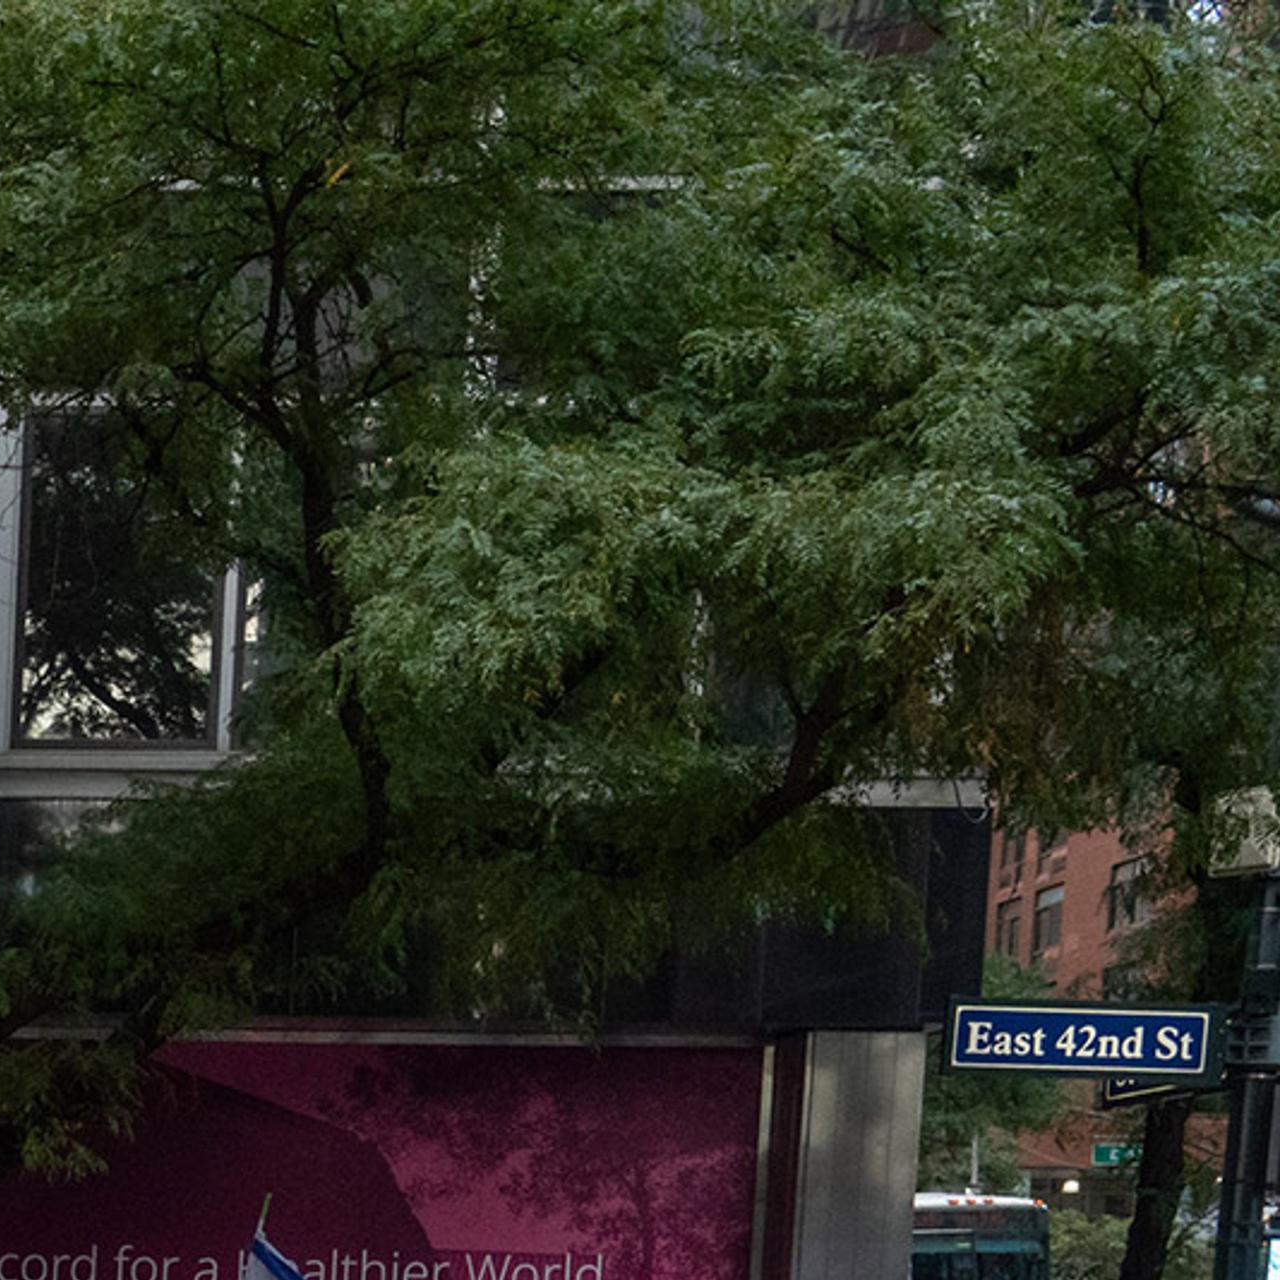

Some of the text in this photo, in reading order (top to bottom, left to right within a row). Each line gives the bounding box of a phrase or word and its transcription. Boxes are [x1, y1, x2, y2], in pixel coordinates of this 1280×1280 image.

[965, 1021, 1194, 1061] East 42nd St
